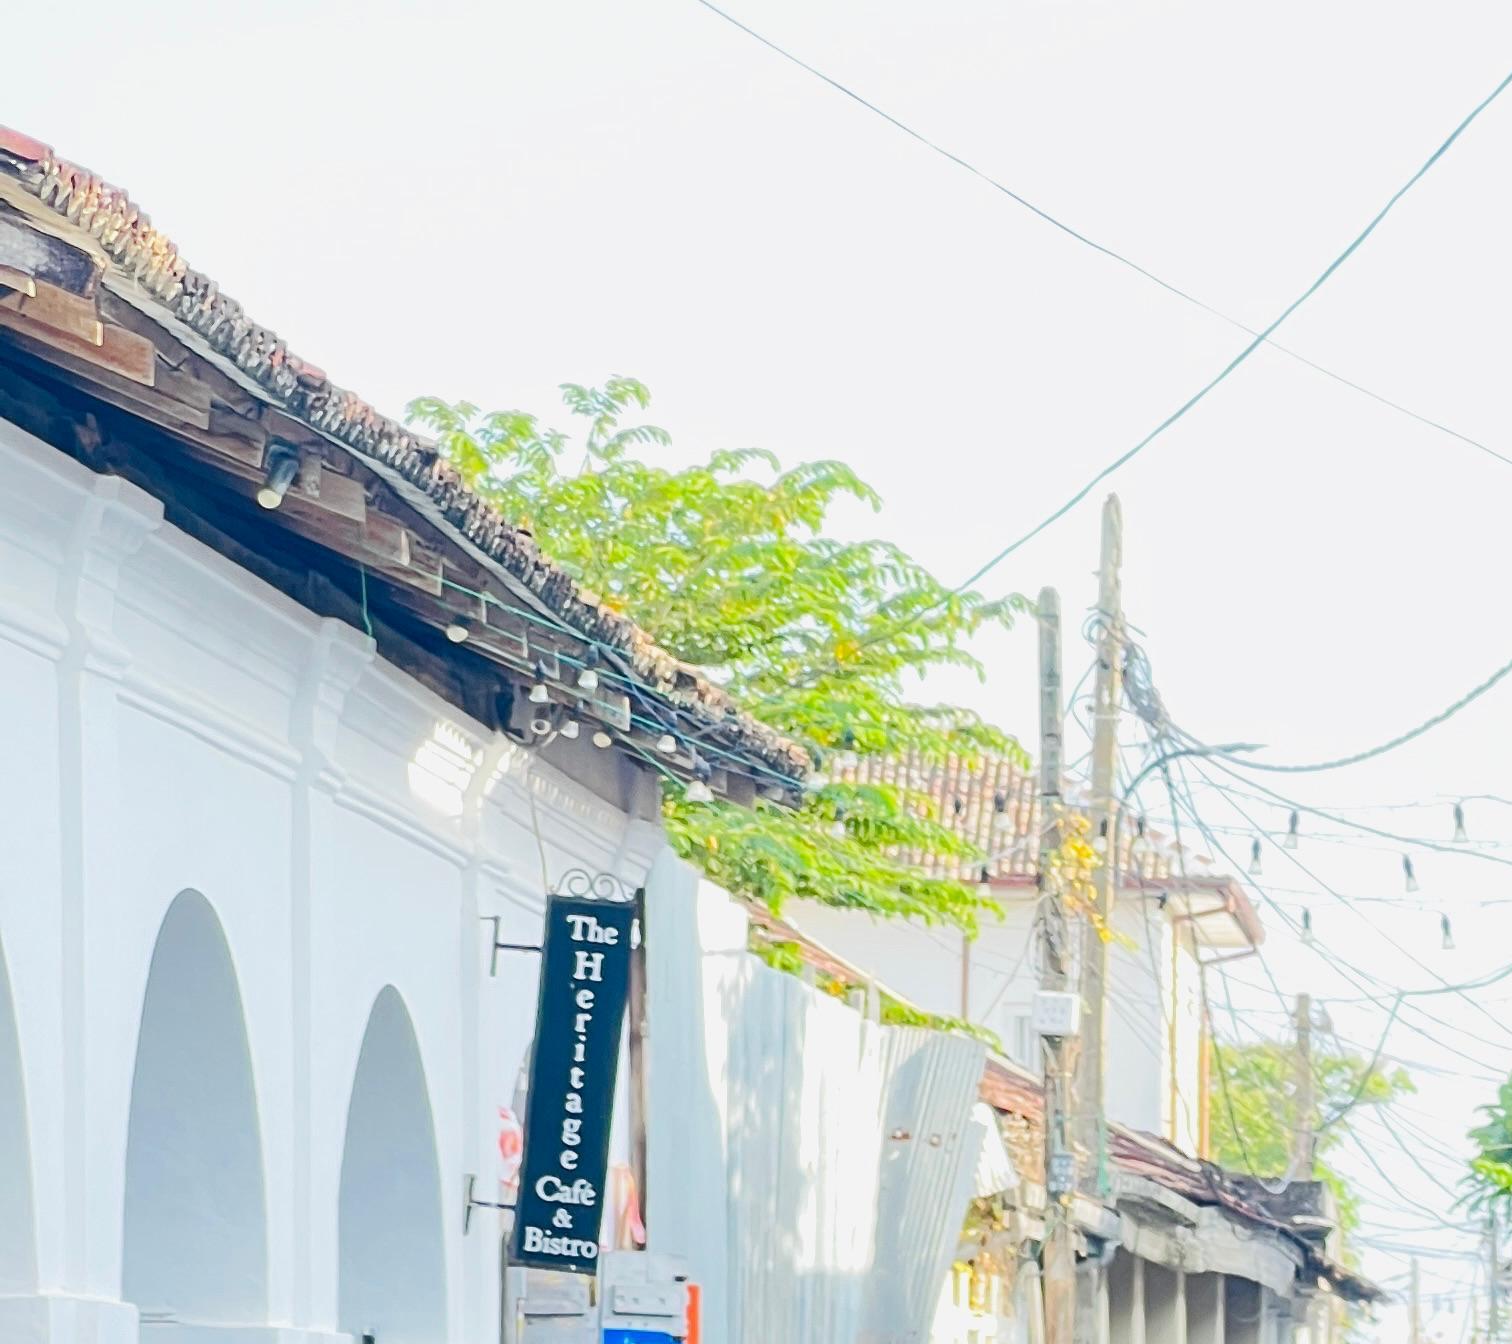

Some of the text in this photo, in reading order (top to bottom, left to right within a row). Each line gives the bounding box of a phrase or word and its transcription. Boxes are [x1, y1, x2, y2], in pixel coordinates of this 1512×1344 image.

[566, 914, 619, 945] The
[559, 951, 603, 1170] Heritage
[552, 1208, 573, 1229] &
[523, 1226, 598, 1259] Bistro
